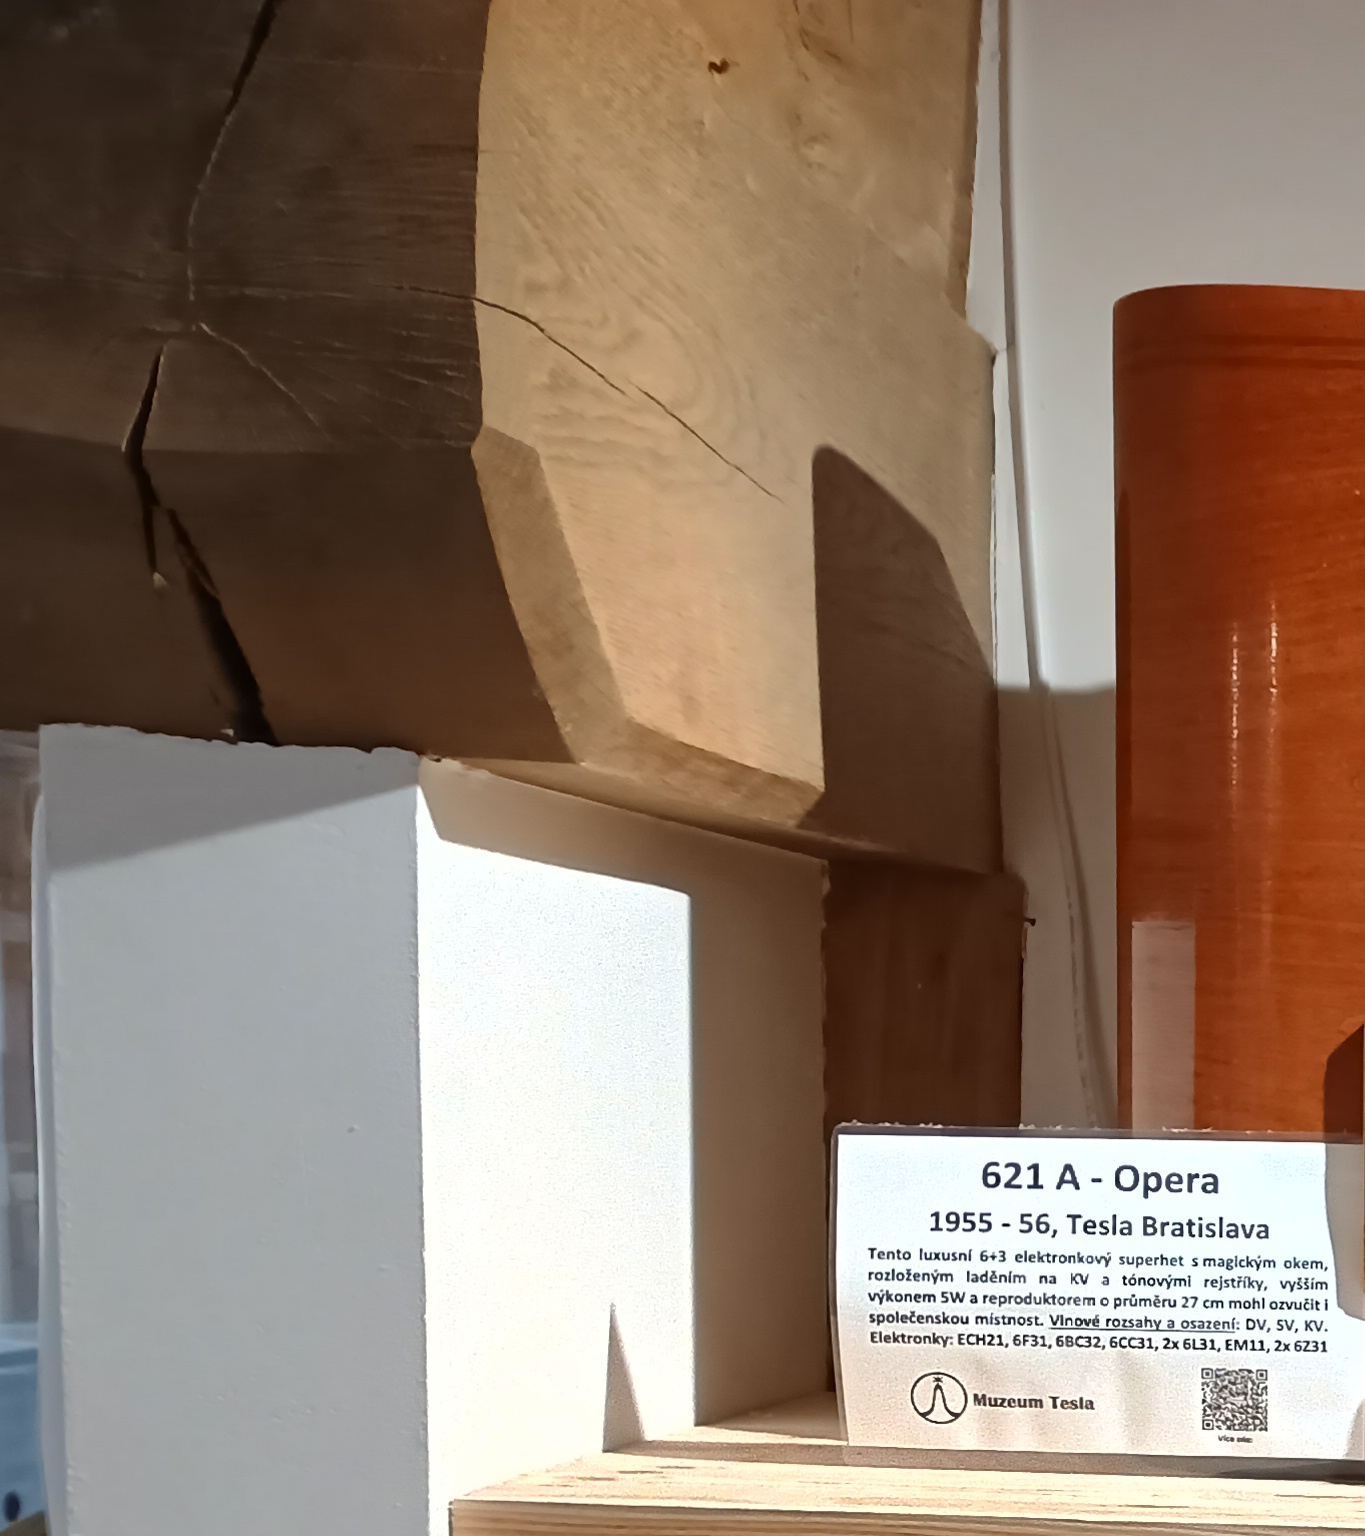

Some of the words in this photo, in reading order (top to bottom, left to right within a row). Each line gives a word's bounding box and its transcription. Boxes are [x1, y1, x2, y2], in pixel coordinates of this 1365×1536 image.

[982, 1161, 1044, 1190] 621
[1055, 1163, 1081, 1191] A
[1115, 1165, 1219, 1200] Opera
[930, 1211, 992, 1233] 1955
[1019, 1213, 1058, 1239] 56,
[1066, 1213, 1133, 1236] Tesla
[1142, 1216, 1269, 1240] Bratislava
[867, 1247, 912, 1261] Tento
[919, 1247, 973, 1262] luxusní
[979, 1250, 1007, 1263] 6+3
[1014, 1250, 1112, 1268] elektronkový
[1119, 1253, 1184, 1269] superhet
[1191, 1257, 1199, 1267] s
[1203, 1255, 1276, 1272] magickým
[1283, 1256, 1328, 1272] okem,
[868, 1268, 954, 1285] rozloženým
[966, 1270, 1027, 1284] laděním
[1039, 1275, 1057, 1285] na
[1070, 1272, 1089, 1285] KV
[1101, 1276, 1110, 1286] a
[1121, 1273, 1191, 1290] tónovými
[1203, 1275, 1268, 1292] rejstříky,
[1279, 1277, 1328, 1293] vyšším
[867, 1289, 936, 1305] výkonem
[969, 1294, 978, 1304] a
[982, 1292, 1096, 1308] reproduktorem
[1100, 1297, 1109, 1307] o
[1113, 1294, 1177, 1310] průměru
[1181, 1296, 1199, 1309] 27
[1203, 1299, 1224, 1309] cm
[1228, 1297, 1265, 1310] mohl
[1269, 1298, 1321, 1311] ozvučit
[1324, 1298, 1328, 1311] i
[869, 1310, 969, 1326] společenskou
[975, 1312, 1044, 1326] místnost.
[1049, 1314, 1100, 1328] Vlnové
[1106, 1316, 1162, 1331] rozsahy
[1167, 1319, 1175, 1329] a
[1180, 1317, 1240, 1330] osazení:
[1246, 1318, 1271, 1333] DV,
[1304, 1320, 1328, 1332] KV.
[870, 1331, 954, 1348] Elektronky:
[957, 1333, 1009, 1349] ECH21,
[1012, 1334, 1052, 1350] 6F31,
[1109, 1336, 1159, 1352] 6CC31,
[1162, 1337, 1180, 1350] 2x
[1183, 1338, 1221, 1353] 6L31,
[1225, 1339, 1270, 1354] EM11,
[1274, 1339, 1291, 1352] 2x
[1294, 1340, 1328, 1353] 6Z31
[973, 1393, 1044, 1409] Muzeum
[1048, 1396, 1095, 1410] Tesla
